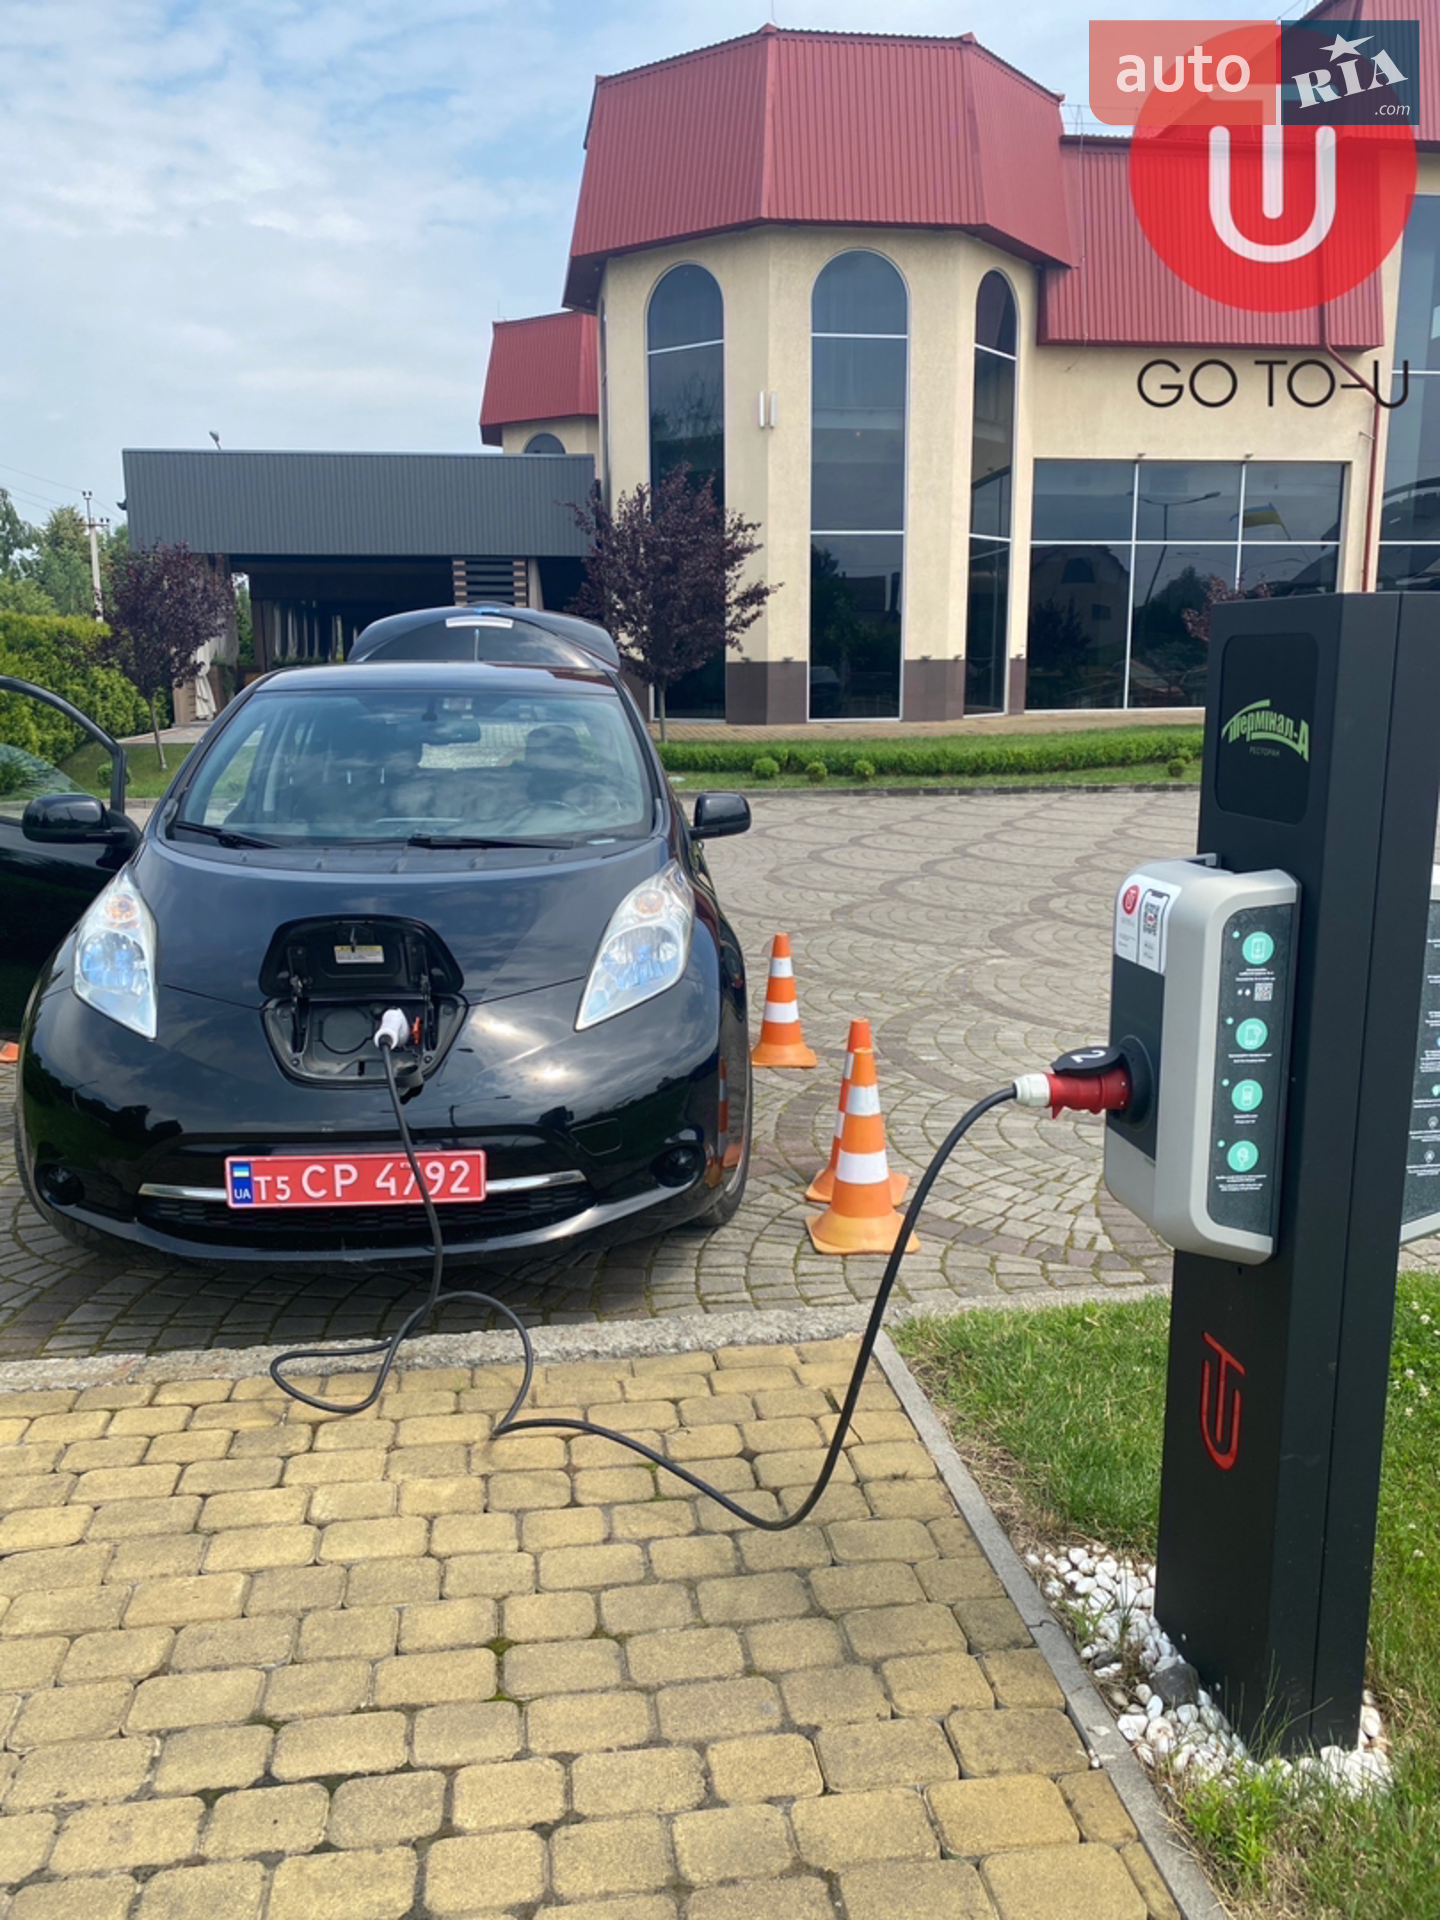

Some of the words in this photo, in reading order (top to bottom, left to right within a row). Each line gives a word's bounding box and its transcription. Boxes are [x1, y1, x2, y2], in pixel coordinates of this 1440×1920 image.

[301, 1164, 358, 1199] CP
[375, 1160, 470, 1196] 4792
[234, 1188, 251, 1199] UA
